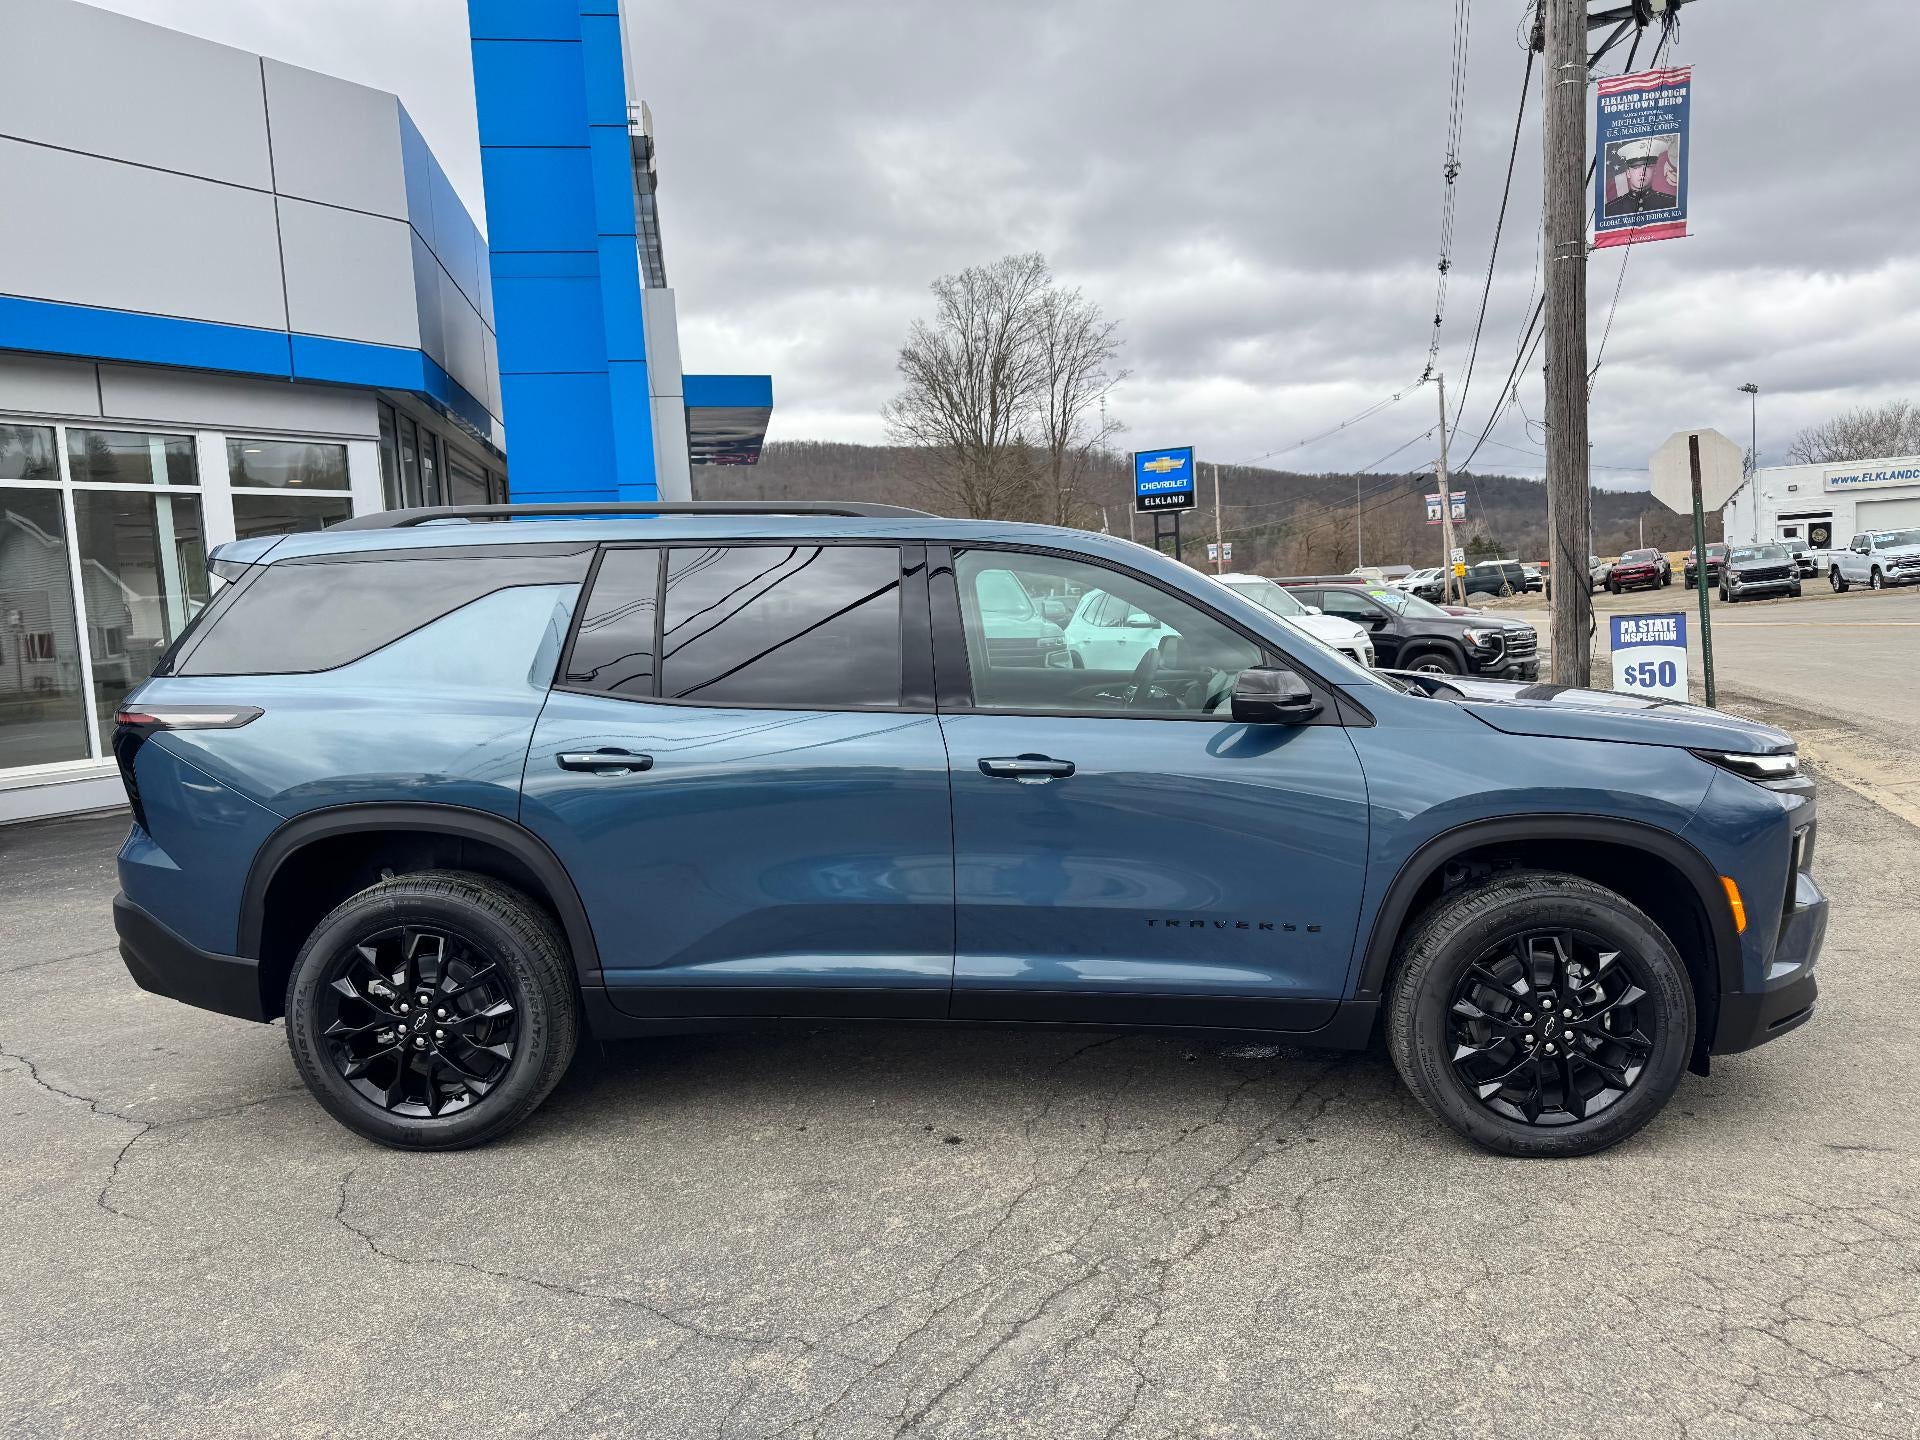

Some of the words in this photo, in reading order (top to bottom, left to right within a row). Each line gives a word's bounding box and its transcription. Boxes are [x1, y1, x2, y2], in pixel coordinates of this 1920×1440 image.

[1601, 93, 1640, 106] ELKLAND
[1642, 87, 1687, 101] BOROUGH
[1604, 99, 1655, 114] HOMETOWN
[1658, 96, 1683, 107] HERO
[1611, 117, 1646, 128] MICHAEL
[1648, 113, 1675, 123] PLANK
[1606, 129, 1620, 138] U.S.
[1621, 125, 1653, 136] MARINE
[1653, 121, 1680, 131] CORPS
[1599, 218, 1622, 228] GLOBAL
[1622, 215, 1636, 224] WAR
[1635, 215, 1645, 223] ON
[1141, 479, 1188, 490] CHEVROLET
[1145, 495, 1185, 506] ELKLAND
[1620, 620, 1637, 633] PA
[1638, 618, 1677, 633] STATE
[1620, 630, 1677, 643] INSPECTION
[1624, 660, 1677, 688] $50
[1145, 919, 1322, 933] TRAVERSE
